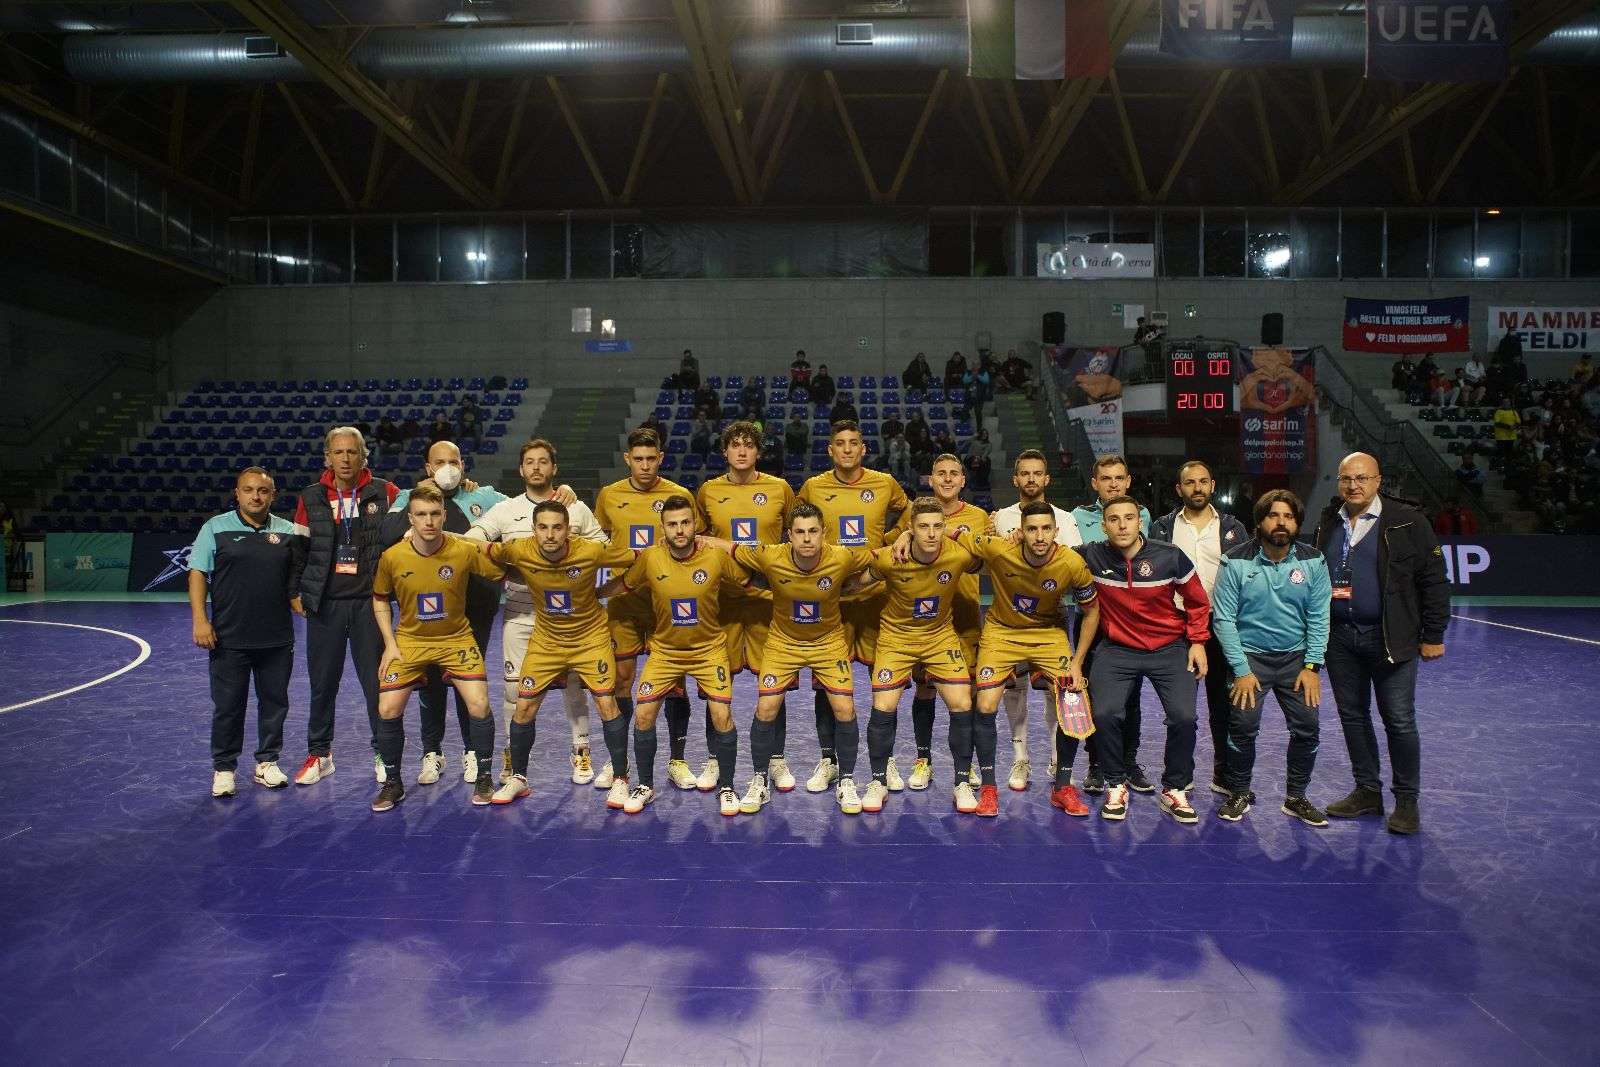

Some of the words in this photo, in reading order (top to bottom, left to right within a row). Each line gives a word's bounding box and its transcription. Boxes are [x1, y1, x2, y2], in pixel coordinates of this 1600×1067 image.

[1179, 0, 1275, 31] FIFA
[1377, 5, 1498, 42] UEFA
[1385, 305, 1409, 315] VAMOS
[1409, 305, 1428, 315] FELDI
[1381, 316, 1391, 325] LA
[1377, 333, 1396, 343] FELDI
[1516, 332, 1587, 350] FELDI
[1171, 352, 1193, 361] LOCALI
[1207, 352, 1229, 360] OSPITI
[1174, 360, 1195, 376] 00
[1209, 360, 1231, 376] 00
[1177, 393, 1198, 409] 20
[1203, 393, 1224, 409] 00
[1262, 417, 1300, 431] sarim
[597, 660, 609, 674] 6
[717, 665, 727, 682] 8
[836, 660, 850, 674] 11
